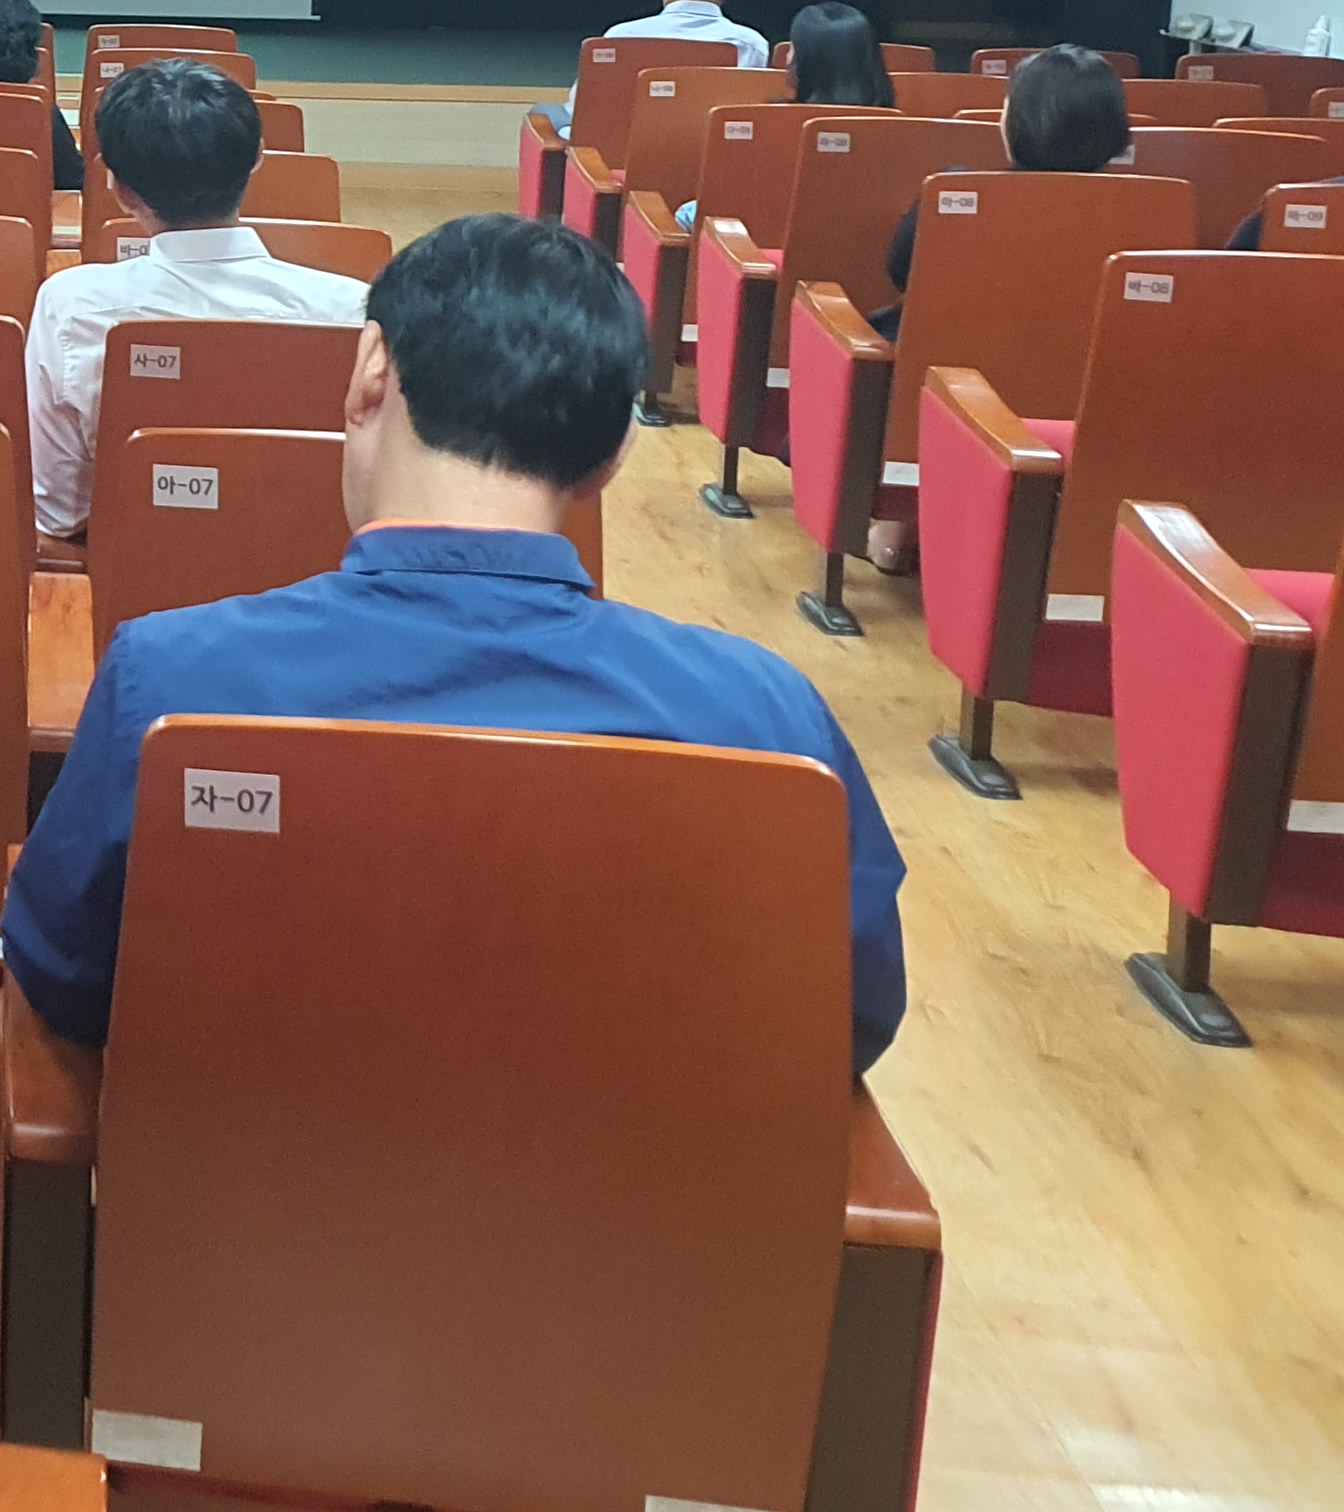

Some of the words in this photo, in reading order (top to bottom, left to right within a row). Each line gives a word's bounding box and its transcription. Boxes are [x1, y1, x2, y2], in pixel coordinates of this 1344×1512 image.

[134, 353, 177, 369] 사-07
[156, 475, 214, 496] 아-07
[190, 784, 273, 814] 자-07
